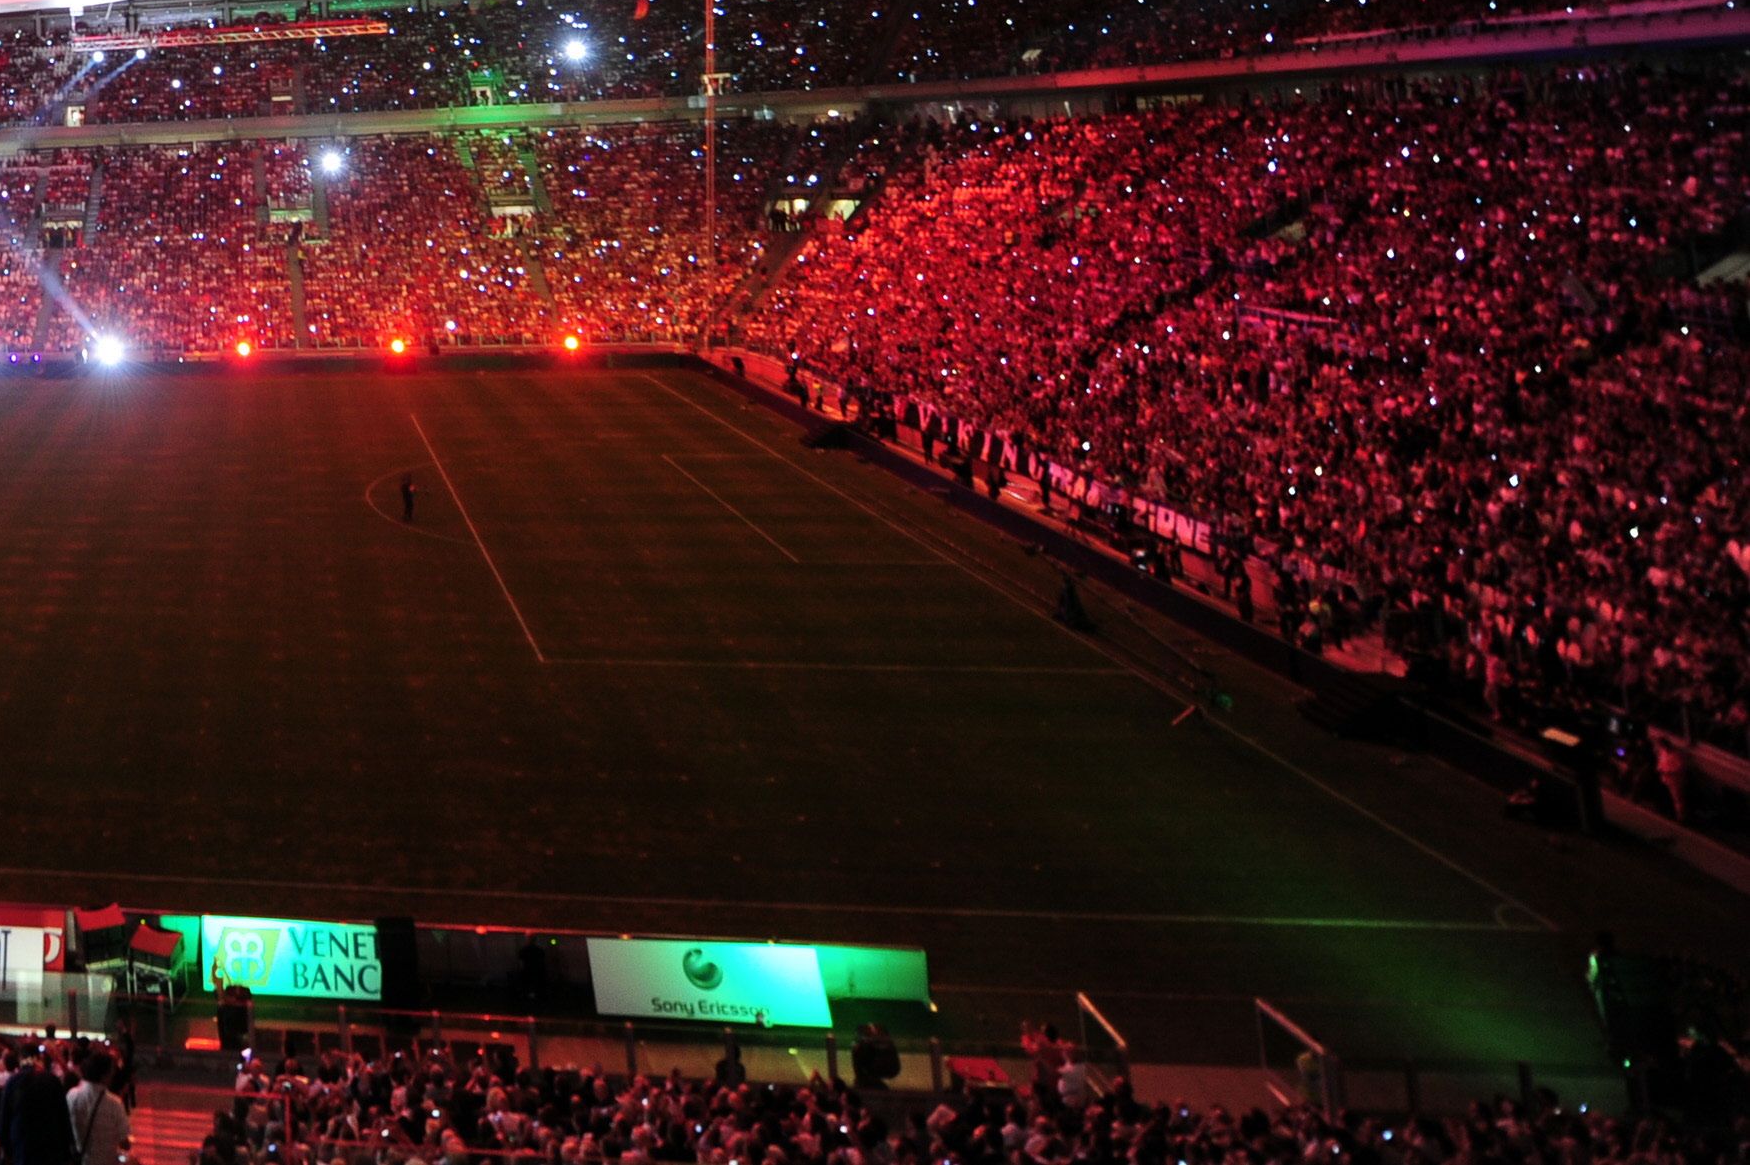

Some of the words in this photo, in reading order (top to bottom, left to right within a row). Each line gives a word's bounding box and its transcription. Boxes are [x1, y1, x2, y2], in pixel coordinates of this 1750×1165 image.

[293, 961, 380, 995] BANC
[651, 997, 694, 1018] Sony
[698, 999, 770, 1018] Ericsson
